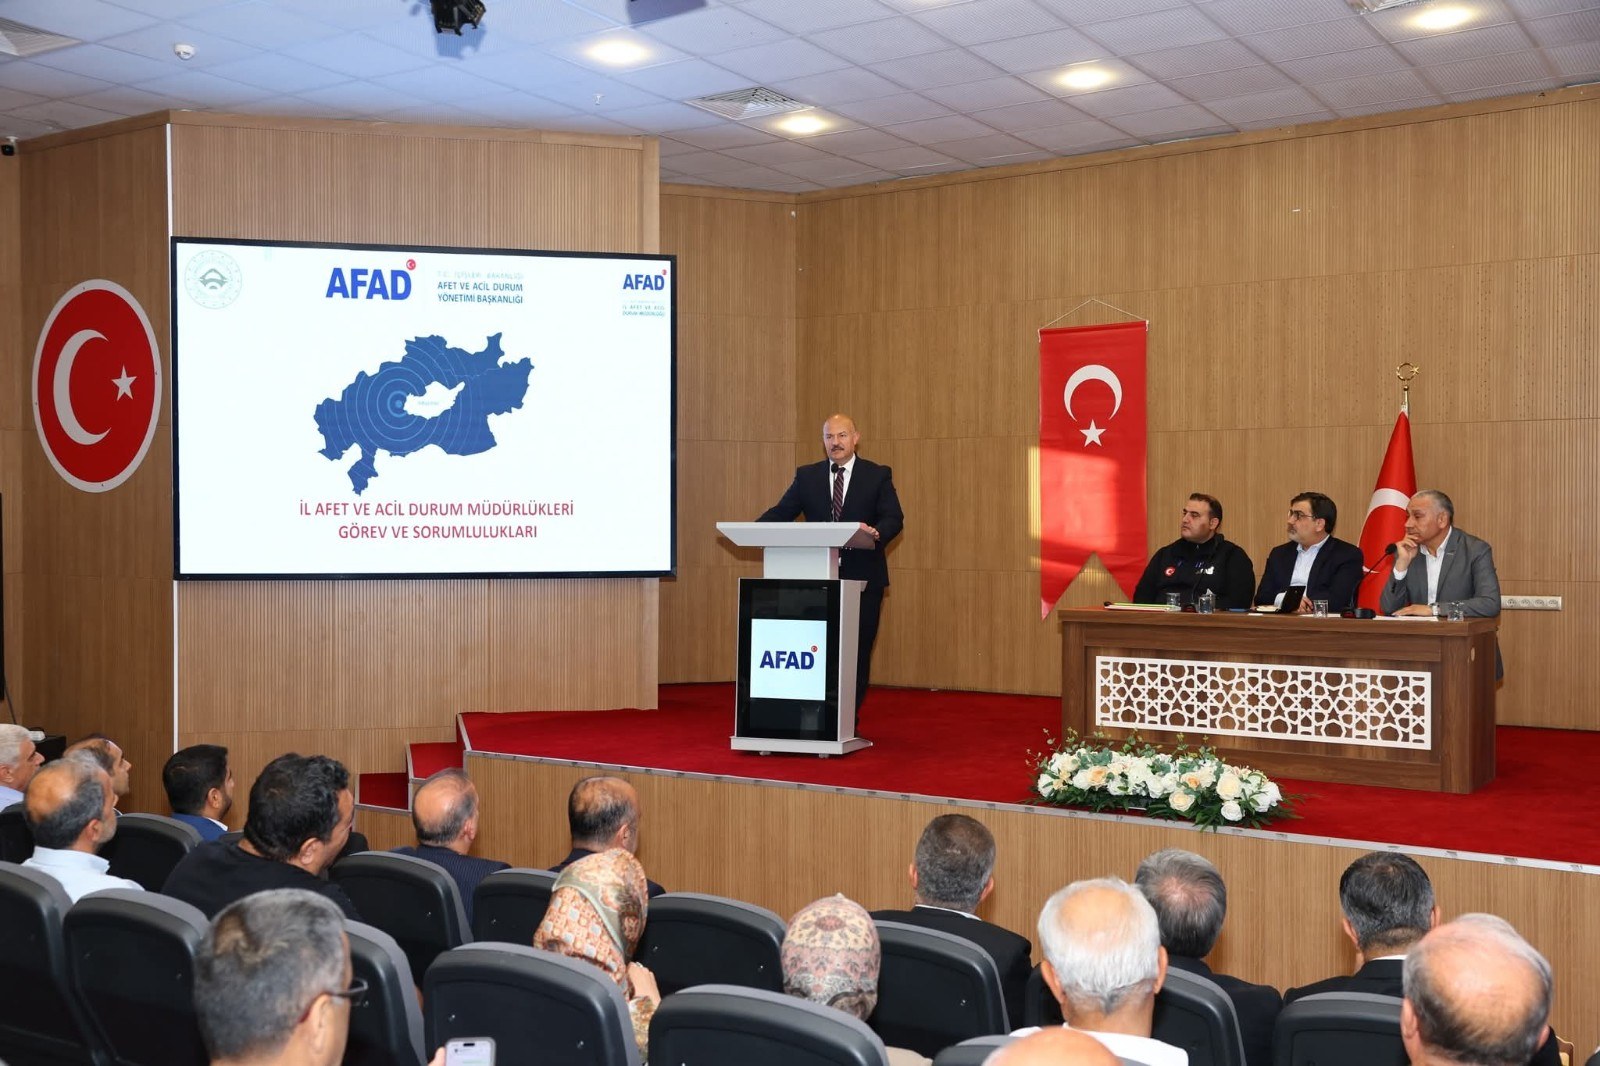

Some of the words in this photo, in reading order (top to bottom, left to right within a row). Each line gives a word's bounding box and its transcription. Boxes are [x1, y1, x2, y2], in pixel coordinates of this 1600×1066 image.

[325, 267, 412, 300] AFAD
[437, 281, 457, 290] AFET
[459, 282, 470, 291] VE
[472, 281, 490, 292] ACİL
[492, 283, 523, 292] DURUM
[622, 274, 665, 291] AFAD
[476, 293, 523, 305] BAŞKANLIĞI
[300, 500, 311, 516] İL
[315, 503, 349, 516] AFET
[353, 503, 370, 516] VE
[375, 500, 404, 516] ACİL
[409, 503, 463, 516] DURUM
[468, 500, 574, 516] MÜDÜRLÜKLERİ
[338, 523, 387, 539] GÖREV
[392, 526, 409, 538] VE
[413, 525, 537, 538] SORUMLULUKLARI
[759, 650, 815, 670] AFAD
